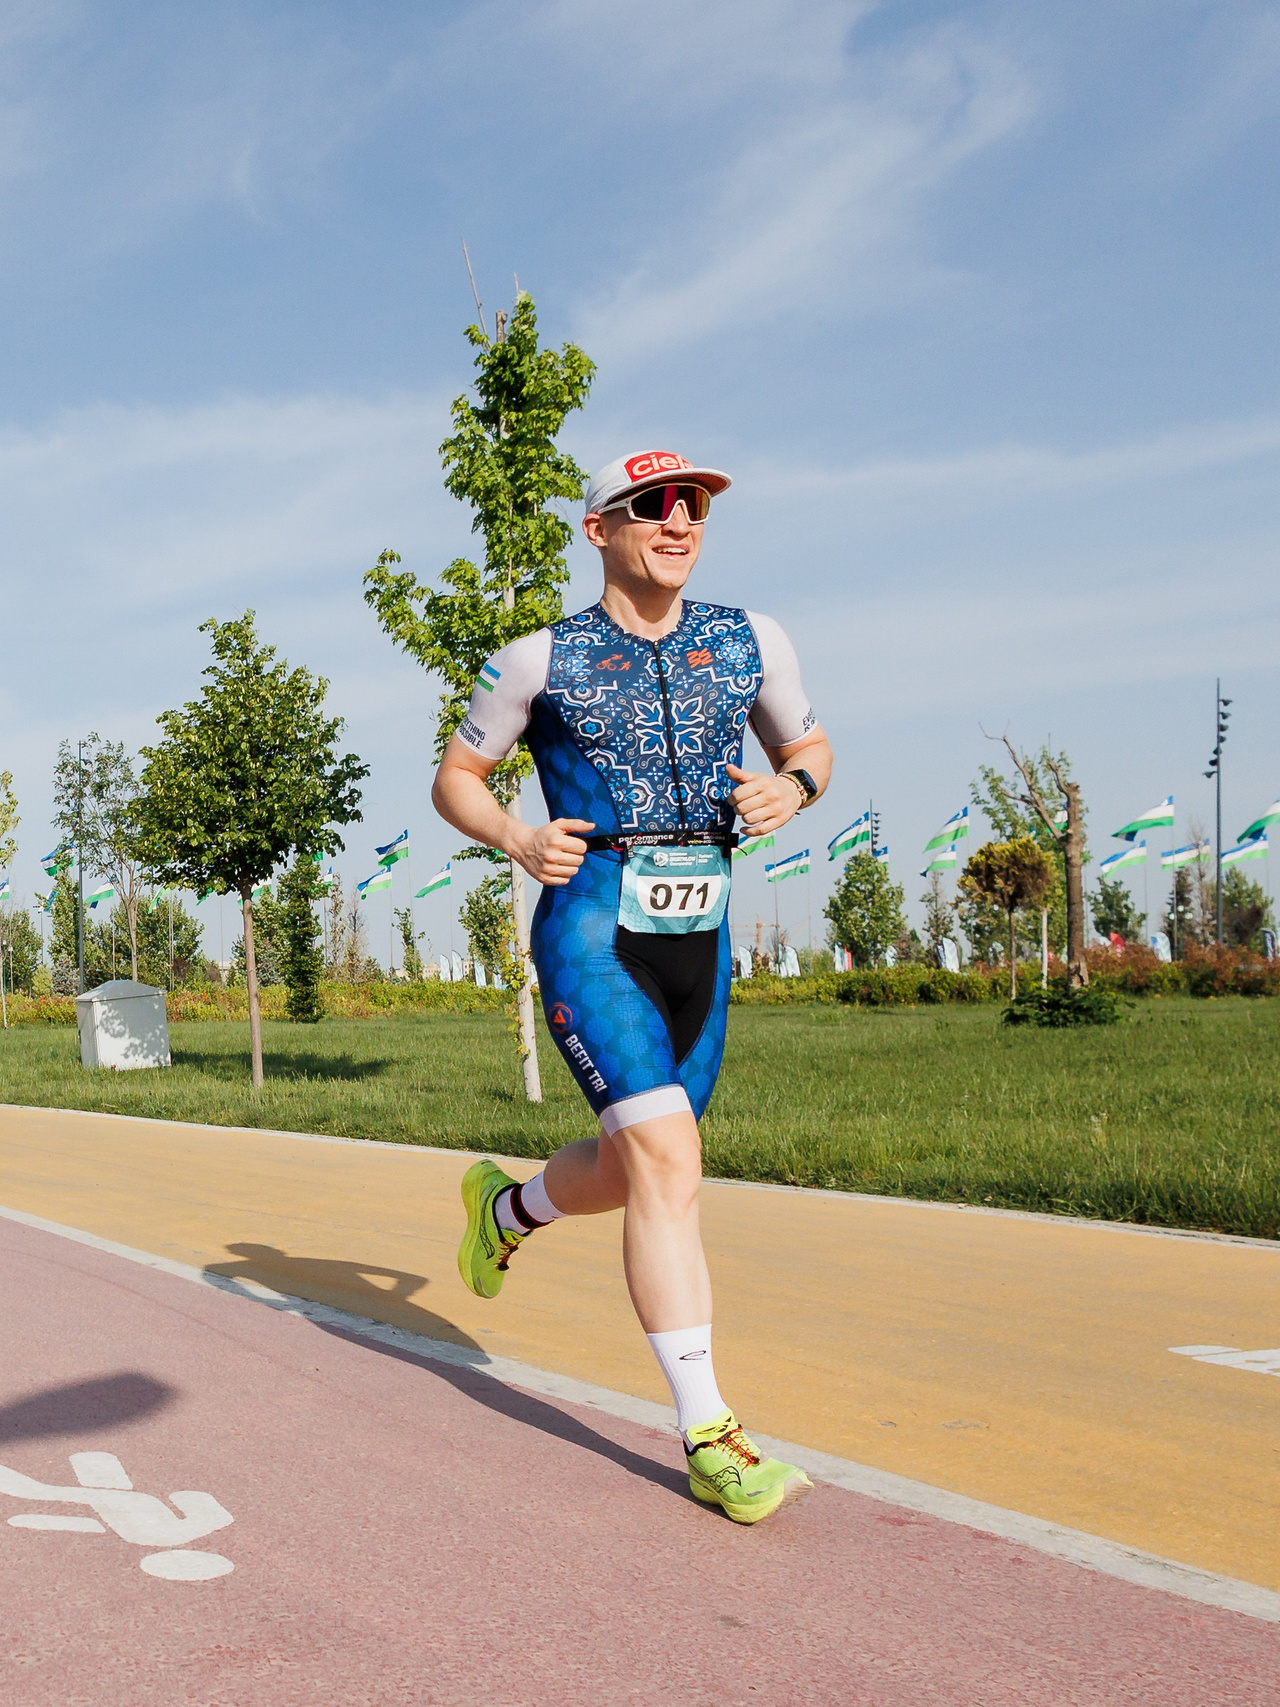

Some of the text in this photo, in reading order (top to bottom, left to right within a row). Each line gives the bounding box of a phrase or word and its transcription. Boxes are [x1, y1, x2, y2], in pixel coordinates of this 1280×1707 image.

[650, 882, 709, 910] 071
[564, 1033, 608, 1093] BEFIT TRI
